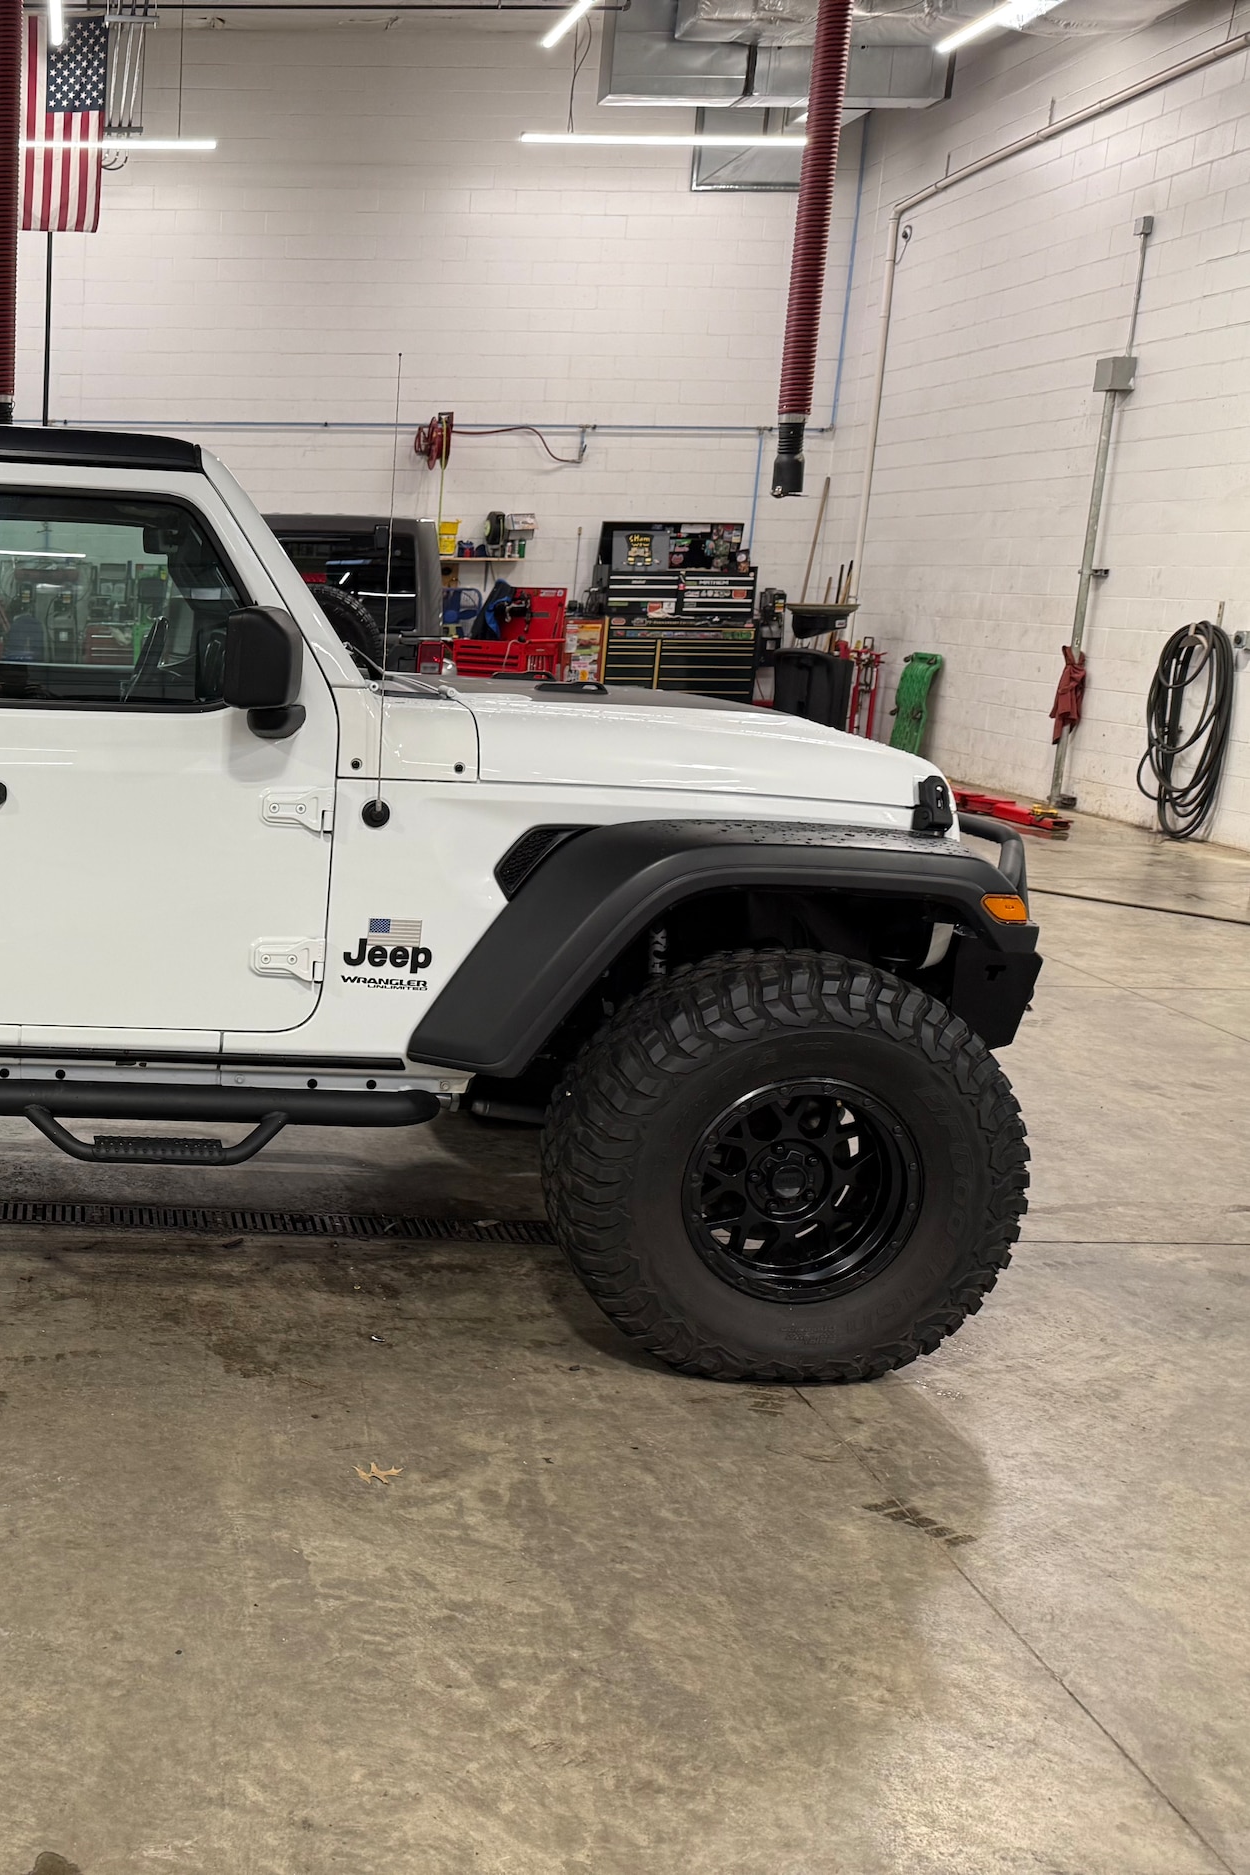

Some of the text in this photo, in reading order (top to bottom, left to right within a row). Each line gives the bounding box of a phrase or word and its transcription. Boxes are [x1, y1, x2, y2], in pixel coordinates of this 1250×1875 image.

[343, 938, 432, 974] Jeep
[648, 927, 668, 975] FOX
[340, 975, 428, 987] WRANGLER
